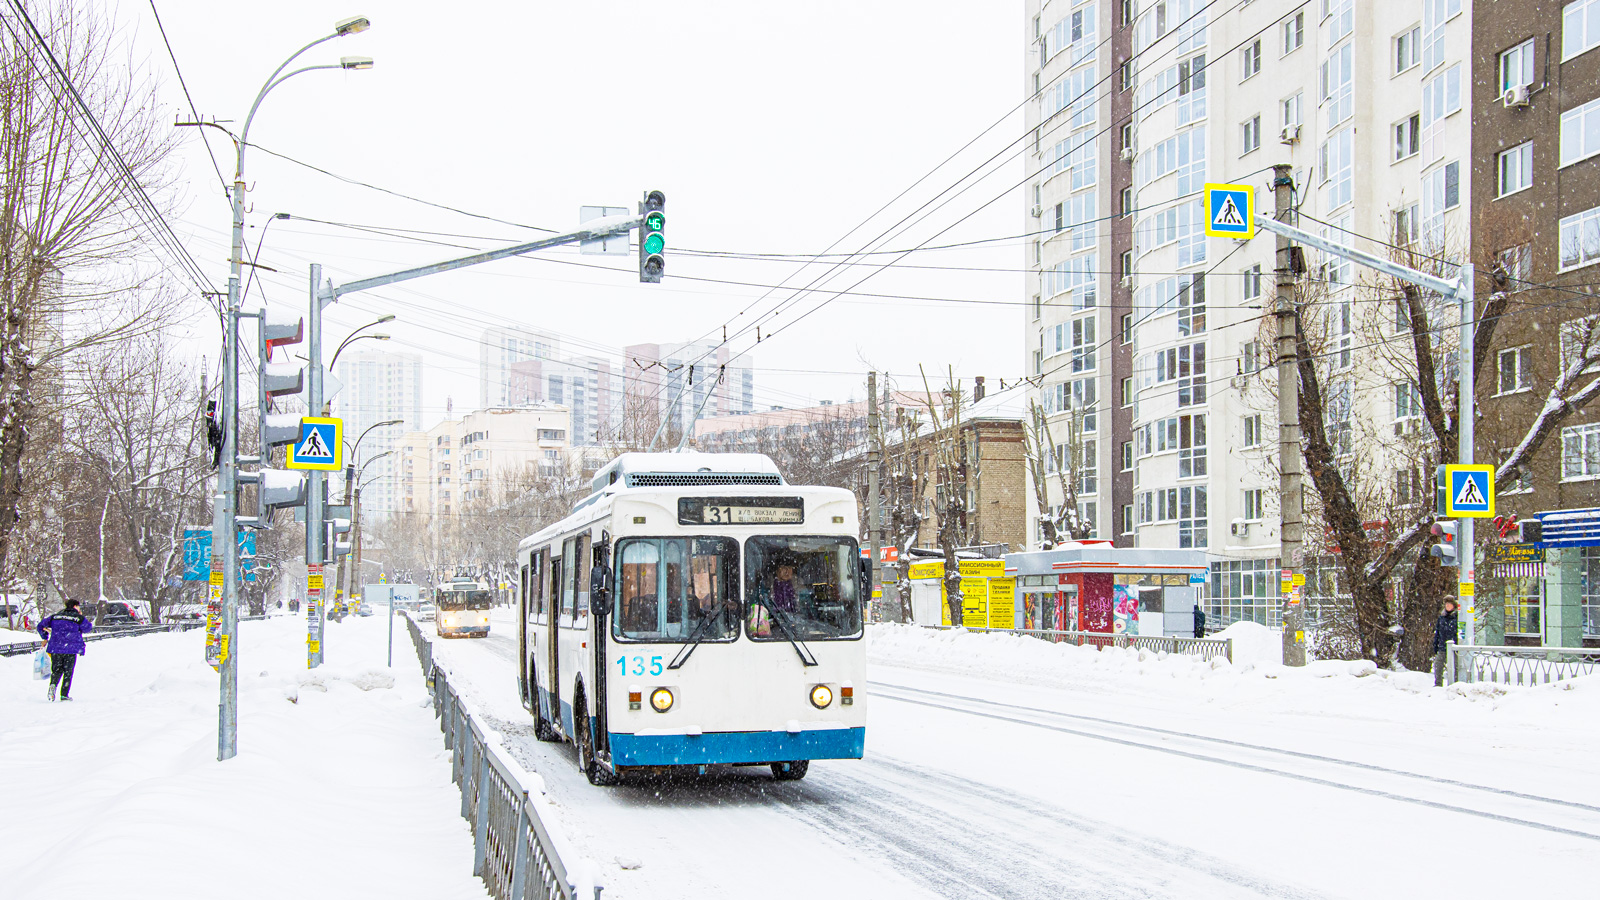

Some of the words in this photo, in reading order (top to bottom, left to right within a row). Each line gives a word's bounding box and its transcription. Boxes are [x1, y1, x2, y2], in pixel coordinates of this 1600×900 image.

[648, 219, 661, 229] 46
[709, 507, 732, 523] 31
[616, 655, 663, 676] 135
